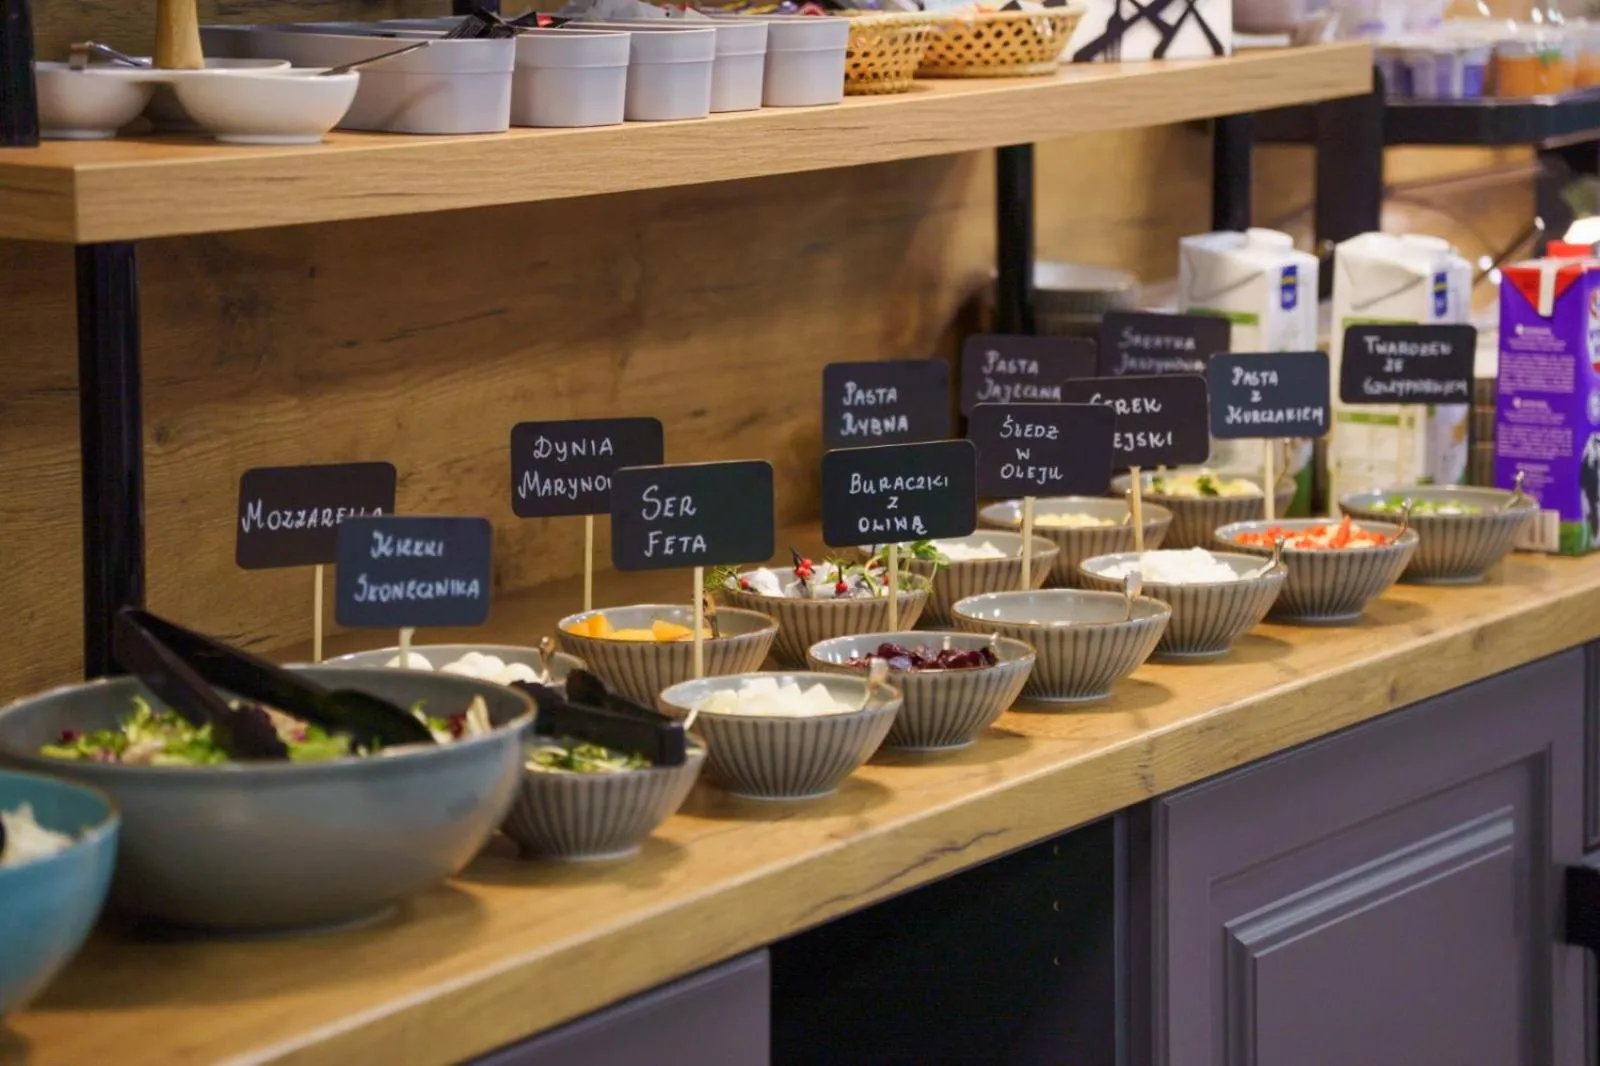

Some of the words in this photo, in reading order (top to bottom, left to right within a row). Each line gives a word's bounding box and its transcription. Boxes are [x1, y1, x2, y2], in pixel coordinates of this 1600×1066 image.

[981, 350, 1039, 375] PASTA
[1231, 365, 1279, 387] PASTA
[842, 381, 898, 406] PASTA
[1089, 393, 1162, 415] REK
[840, 412, 909, 436] RYBNA
[533, 435, 613, 462] DYNIA
[1113, 431, 1173, 452] EJSKI
[1016, 448, 1031, 461] W
[518, 470, 612, 500] MARYNO
[849, 472, 948, 495] BURACZKI
[1000, 463, 1064, 485] OLEJU
[641, 485, 697, 521] SER
[886, 496, 899, 509] Z
[644, 531, 707, 557] FETA
